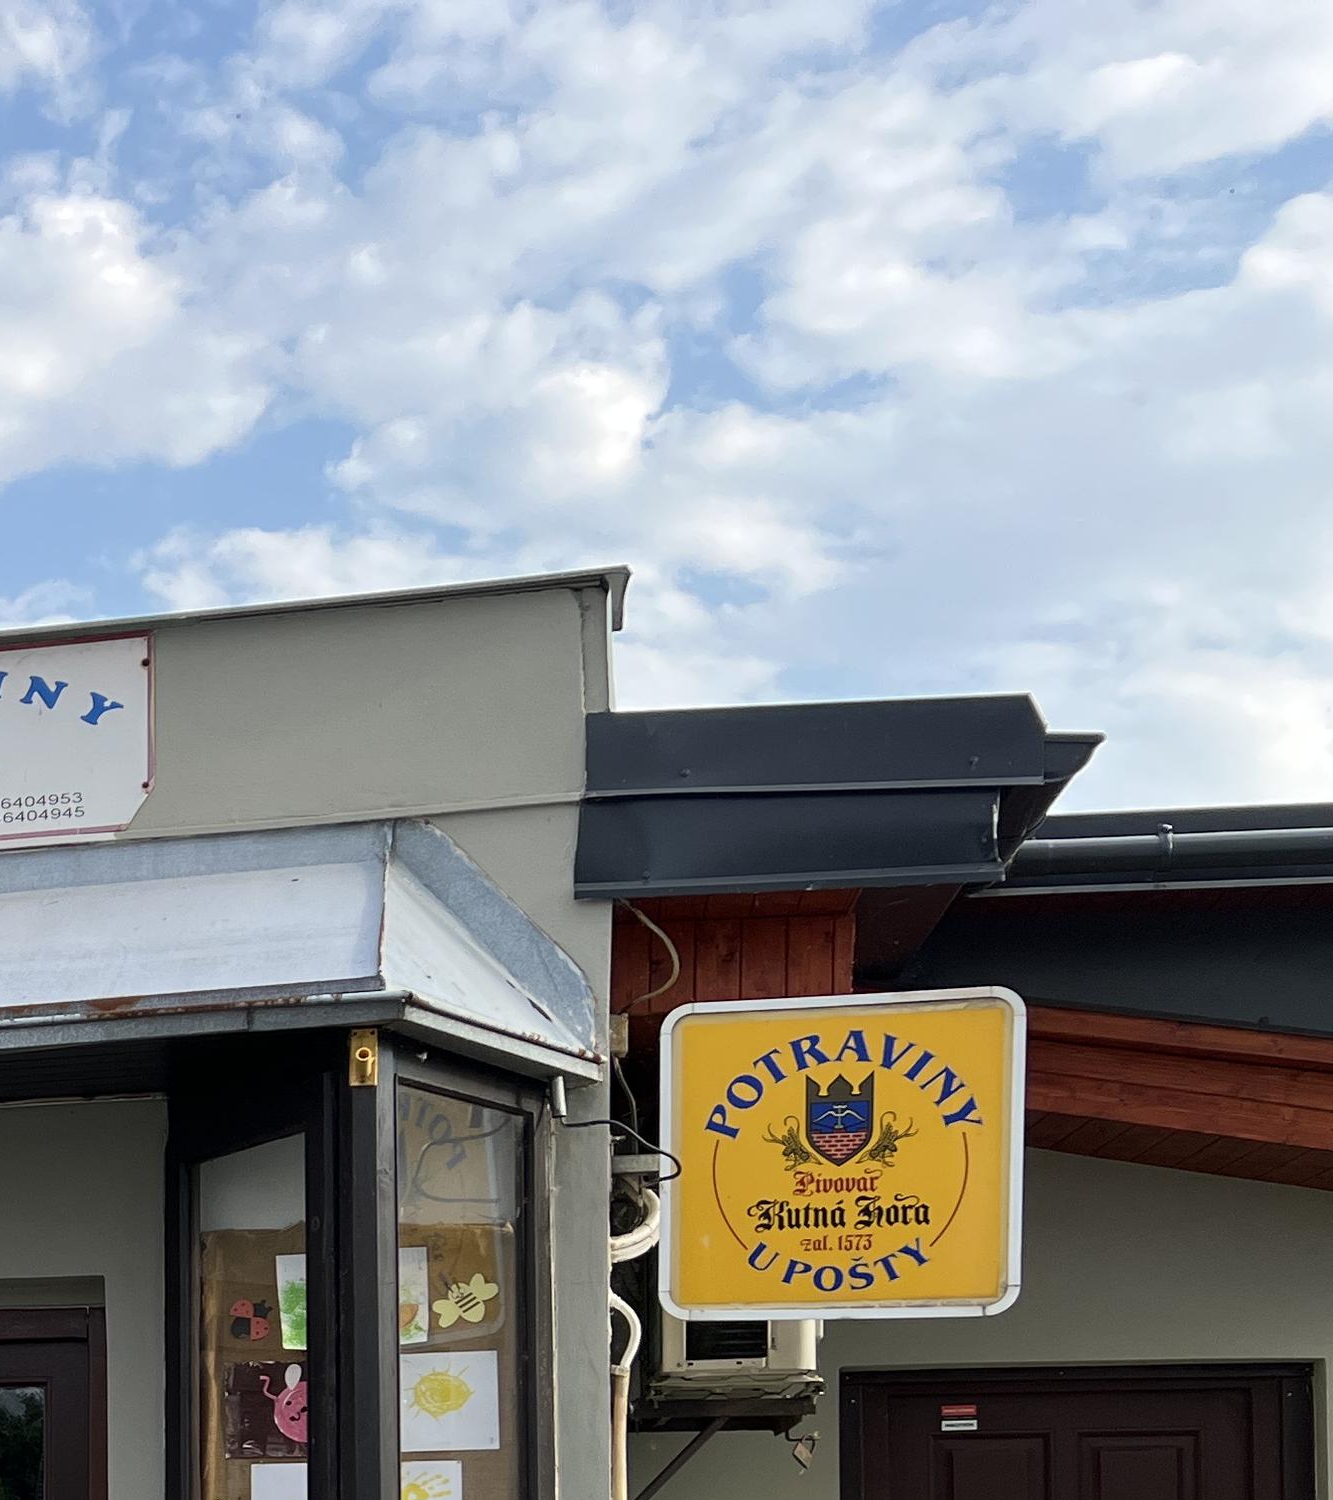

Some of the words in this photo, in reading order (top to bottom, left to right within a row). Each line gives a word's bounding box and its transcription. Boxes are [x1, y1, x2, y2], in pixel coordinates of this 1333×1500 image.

[704, 1029, 983, 1140] POTRAVINY
[793, 1168, 883, 1197] Pivovar
[747, 1199, 846, 1233] Kutná
[854, 1193, 930, 1230] Hora
[800, 1235, 833, 1251] zal.
[838, 1234, 873, 1251] 1573
[747, 1241, 781, 1271] U
[781, 1237, 931, 1292] POŠTY
